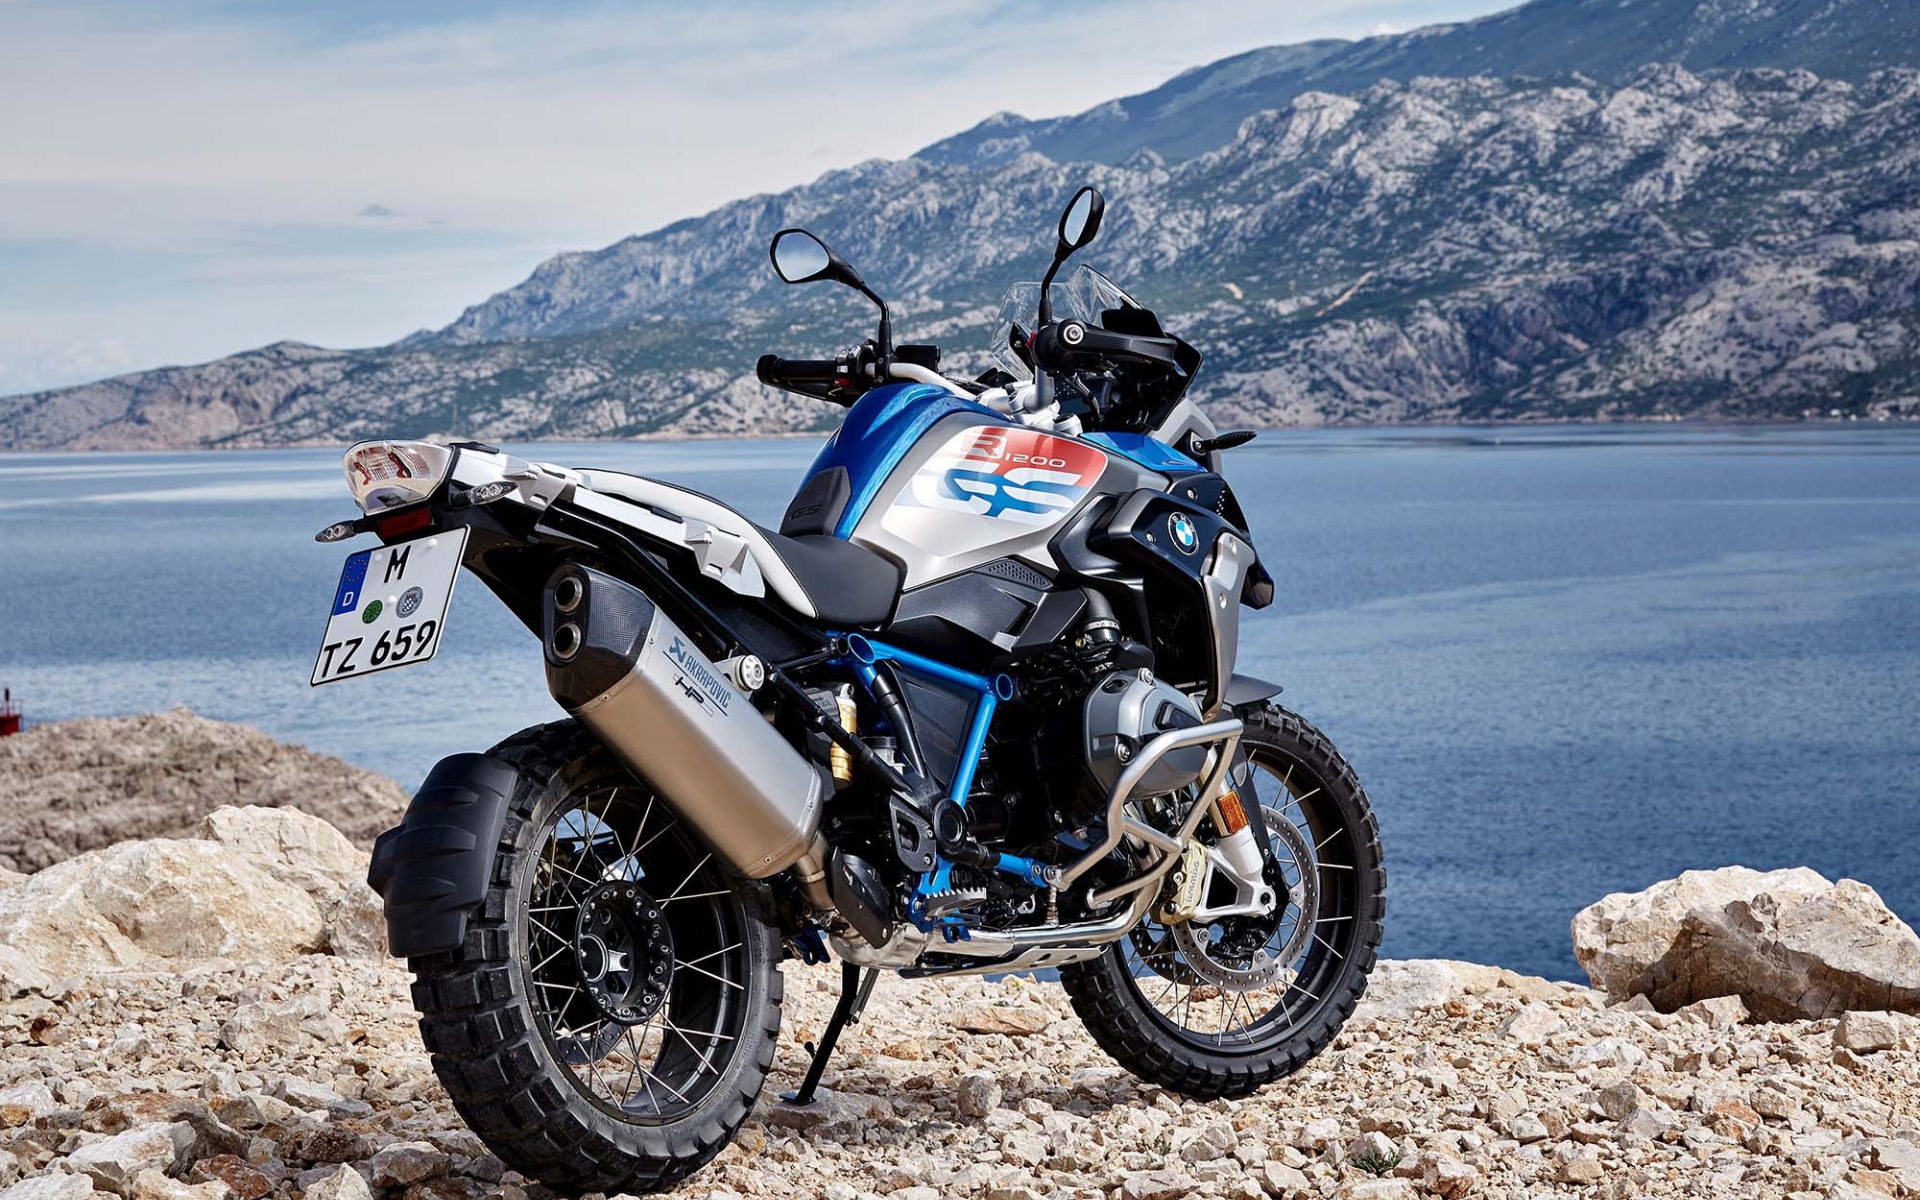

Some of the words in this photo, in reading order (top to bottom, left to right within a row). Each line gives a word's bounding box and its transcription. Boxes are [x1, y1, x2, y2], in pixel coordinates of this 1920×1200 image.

[1004, 454, 1066, 468] 1200
[911, 459, 1083, 526] GS
[383, 544, 412, 584] M
[342, 591, 354, 607] D
[322, 637, 363, 677] TZ
[371, 620, 436, 665] 659
